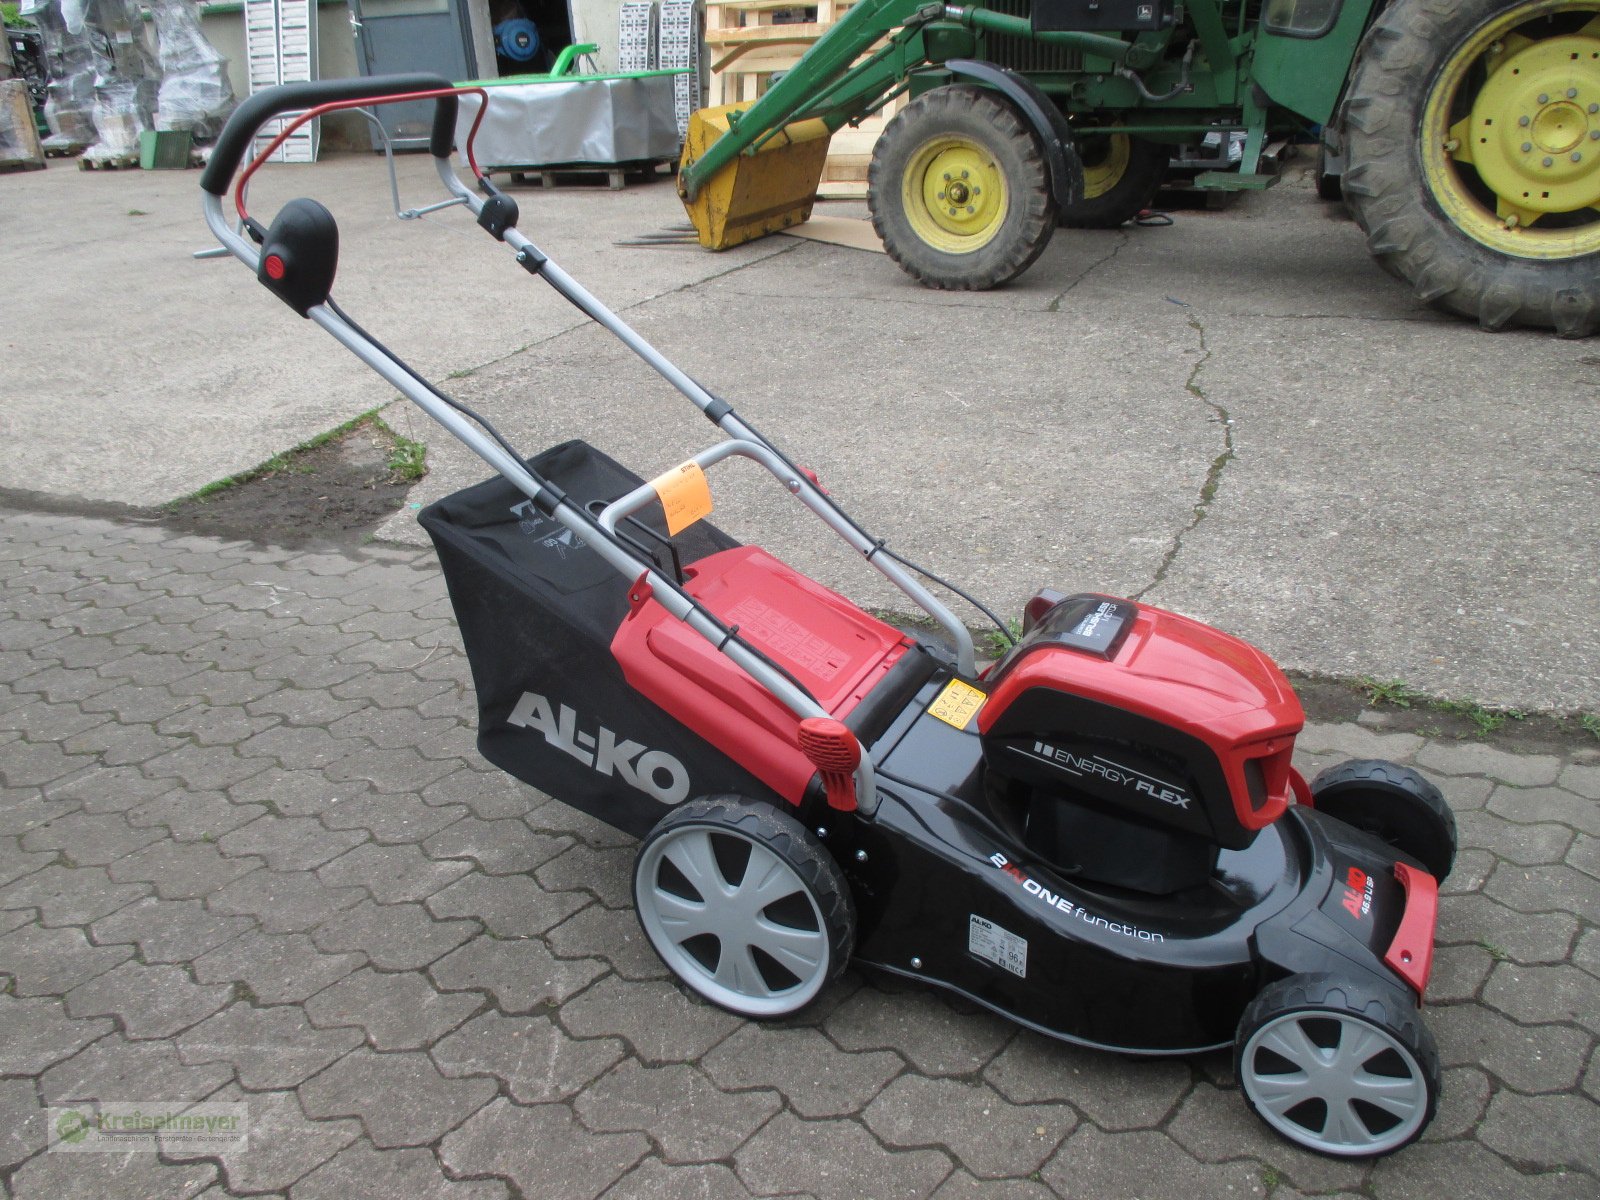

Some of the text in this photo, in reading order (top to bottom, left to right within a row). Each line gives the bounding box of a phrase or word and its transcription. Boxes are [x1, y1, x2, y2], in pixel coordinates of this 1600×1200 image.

[506, 690, 691, 805] AL-KO
[1054, 749, 1191, 809] ENERGY FLEX
[1075, 907, 1164, 943] function
[1008, 951, 1019, 963] 96
